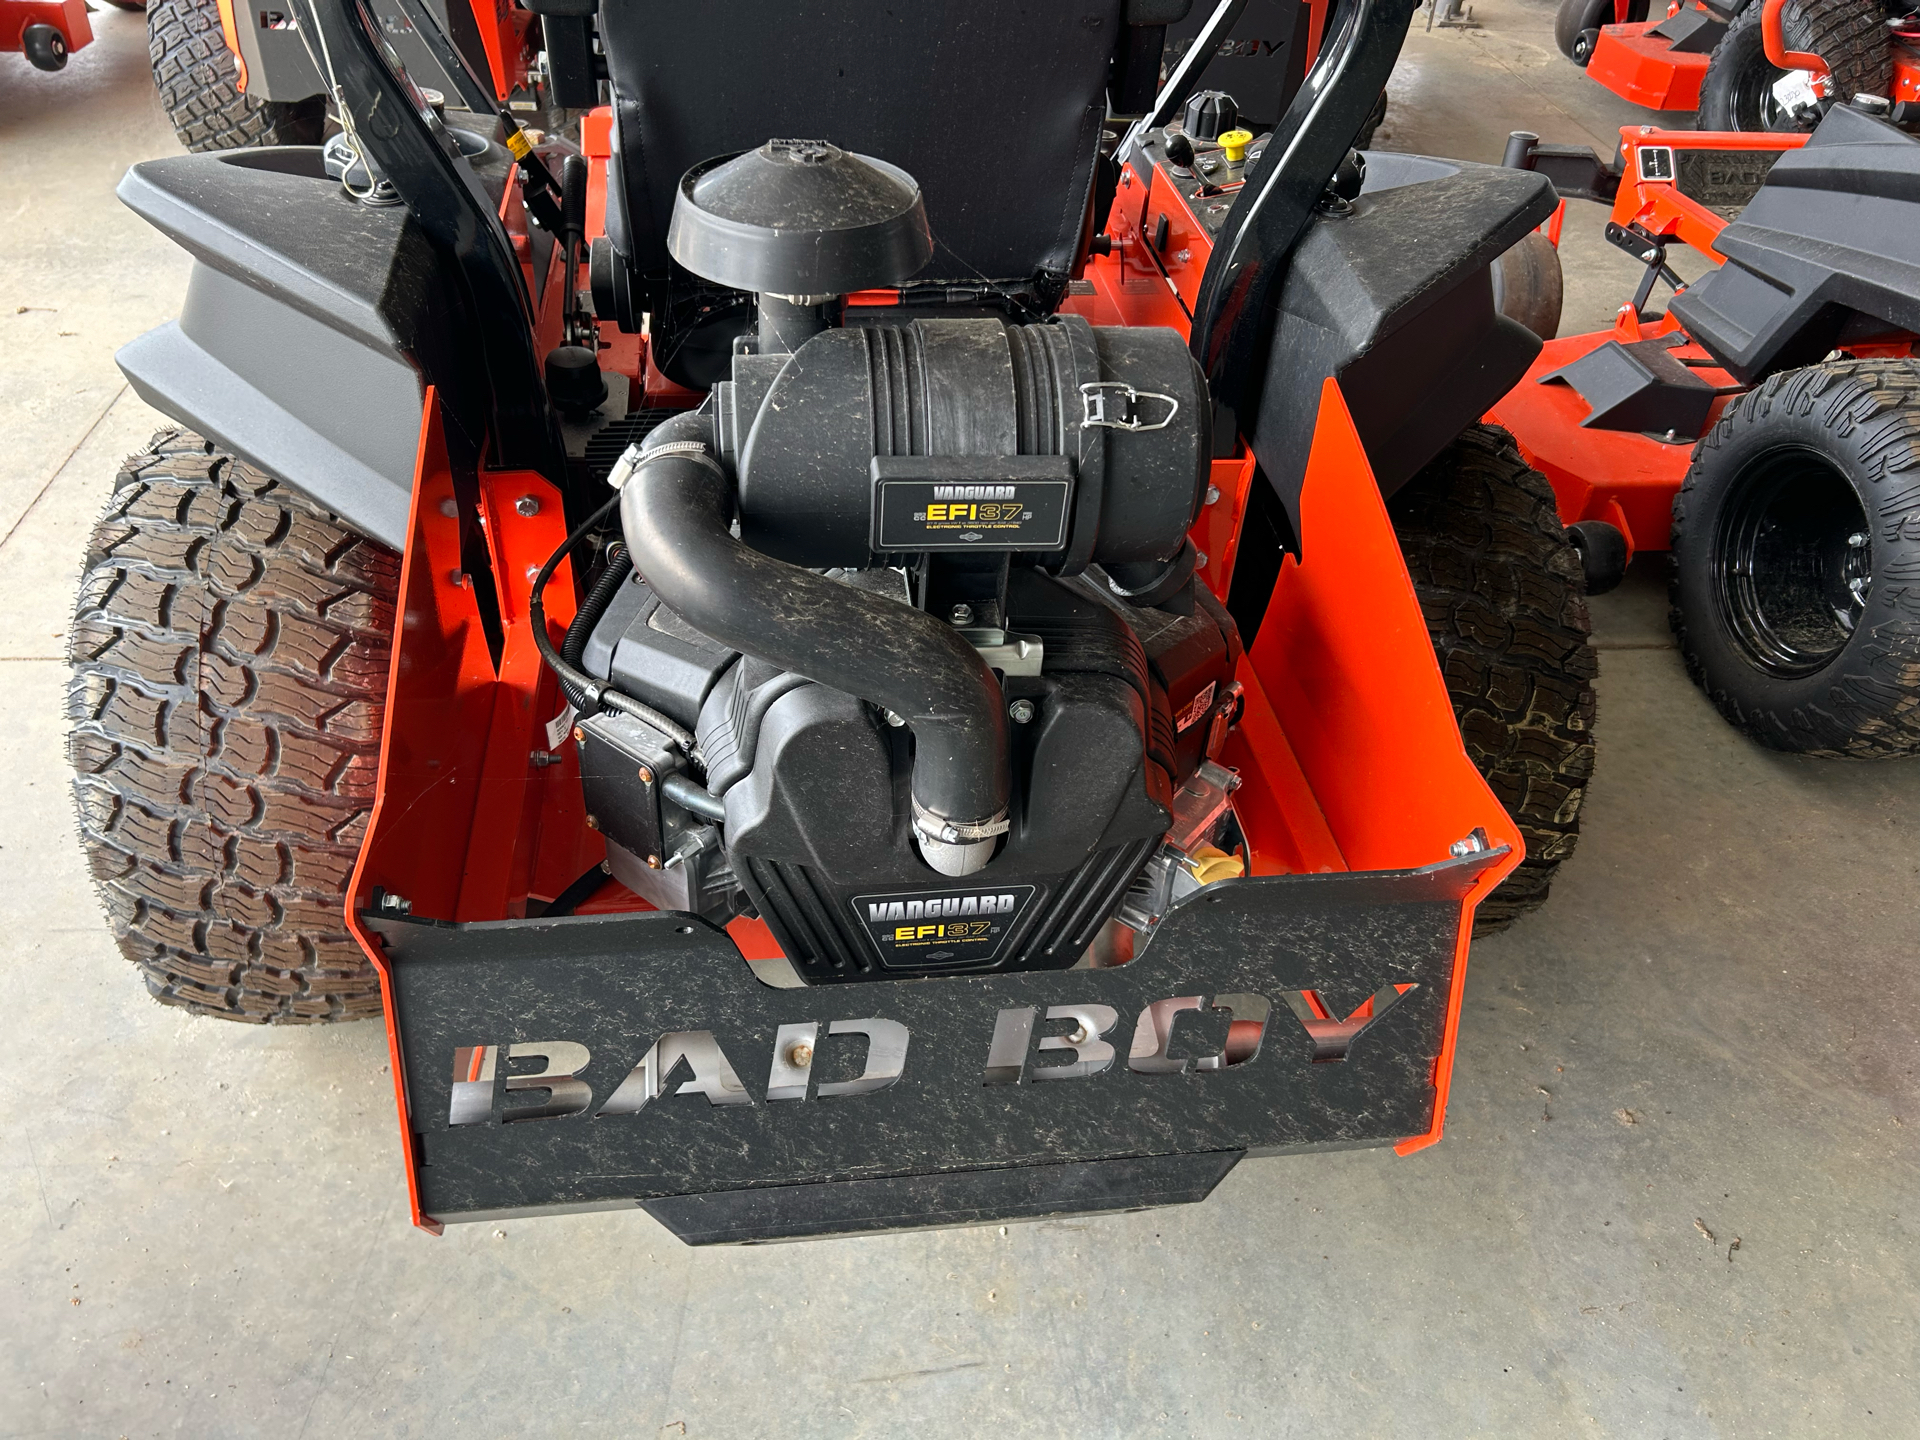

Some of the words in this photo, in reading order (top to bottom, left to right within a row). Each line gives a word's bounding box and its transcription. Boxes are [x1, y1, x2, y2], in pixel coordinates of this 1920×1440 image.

[934, 486, 1016, 500] VANGUARD
[869, 894, 1015, 922] VANGUARD
[448, 1017, 910, 1129] BAD
[982, 982, 1420, 1088] BOY
